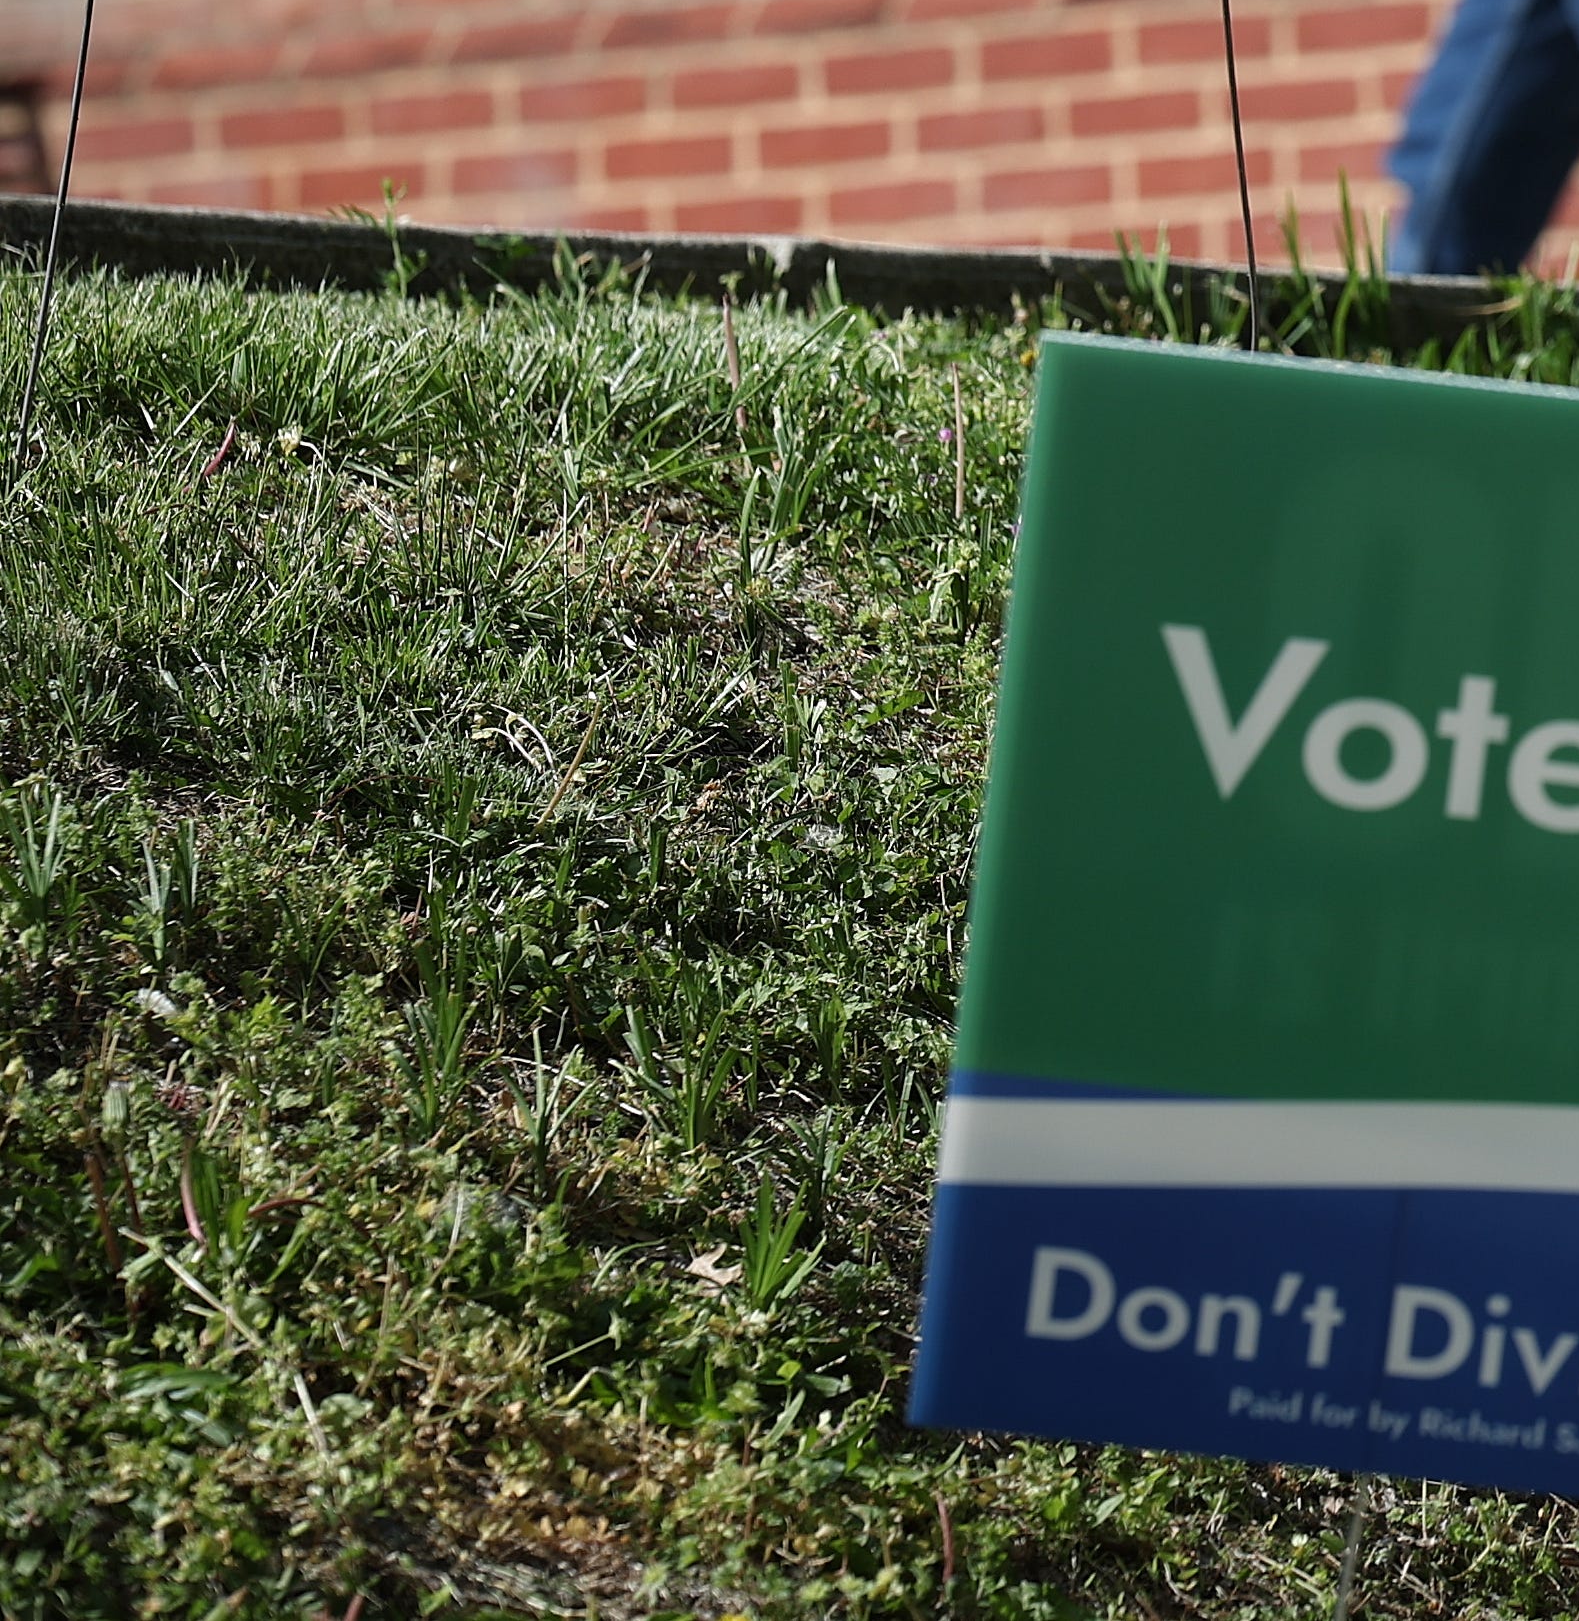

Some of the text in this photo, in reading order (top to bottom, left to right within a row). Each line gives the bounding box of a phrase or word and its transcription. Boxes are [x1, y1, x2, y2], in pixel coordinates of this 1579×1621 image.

[1024, 1246, 1345, 1368] Don't
[1229, 1387, 1300, 1423] Paid
[1310, 1393, 1357, 1428] for
[1369, 1399, 1410, 1440] by
[1420, 1407, 1546, 1451] Richard
